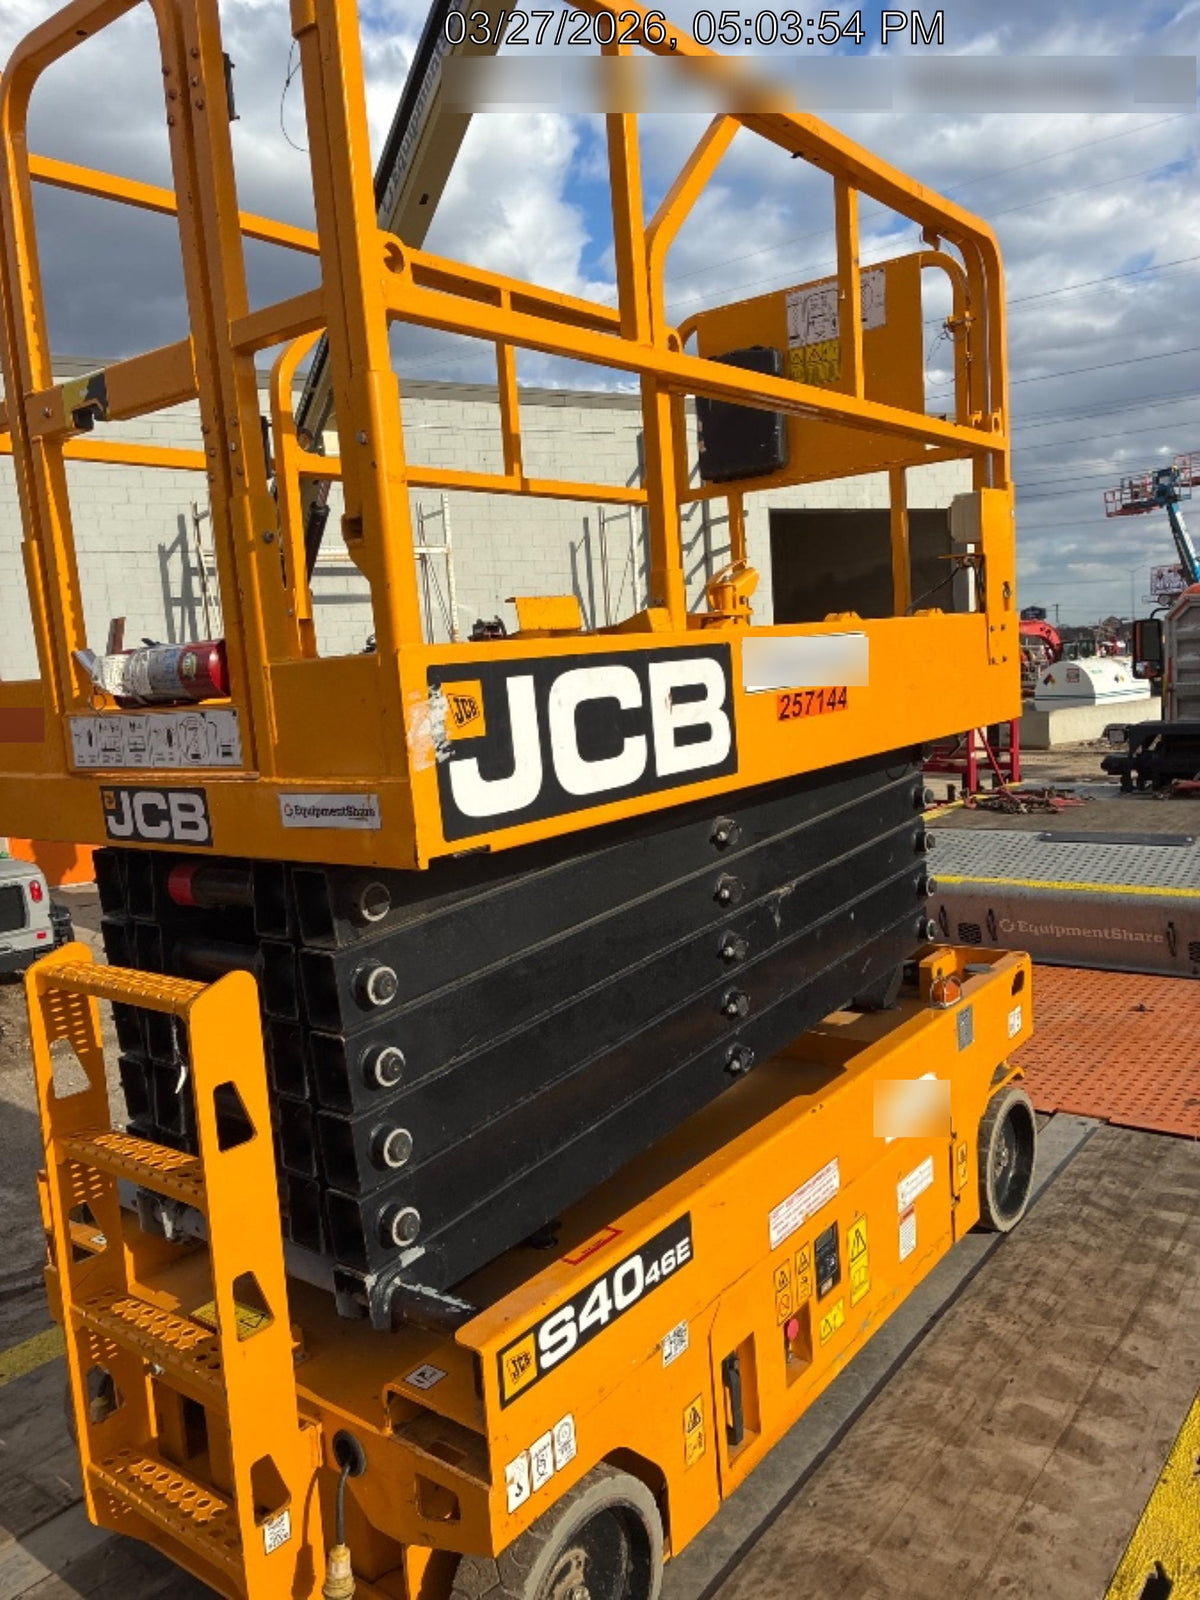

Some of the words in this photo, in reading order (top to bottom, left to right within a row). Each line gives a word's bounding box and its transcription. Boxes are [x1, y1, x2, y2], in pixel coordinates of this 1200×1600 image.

[453, 695, 479, 725] JCB
[778, 686, 848, 721] 257144
[449, 657, 732, 818] JCB
[107, 790, 210, 842] JCB
[1016, 920, 1165, 944] EquipmentShare
